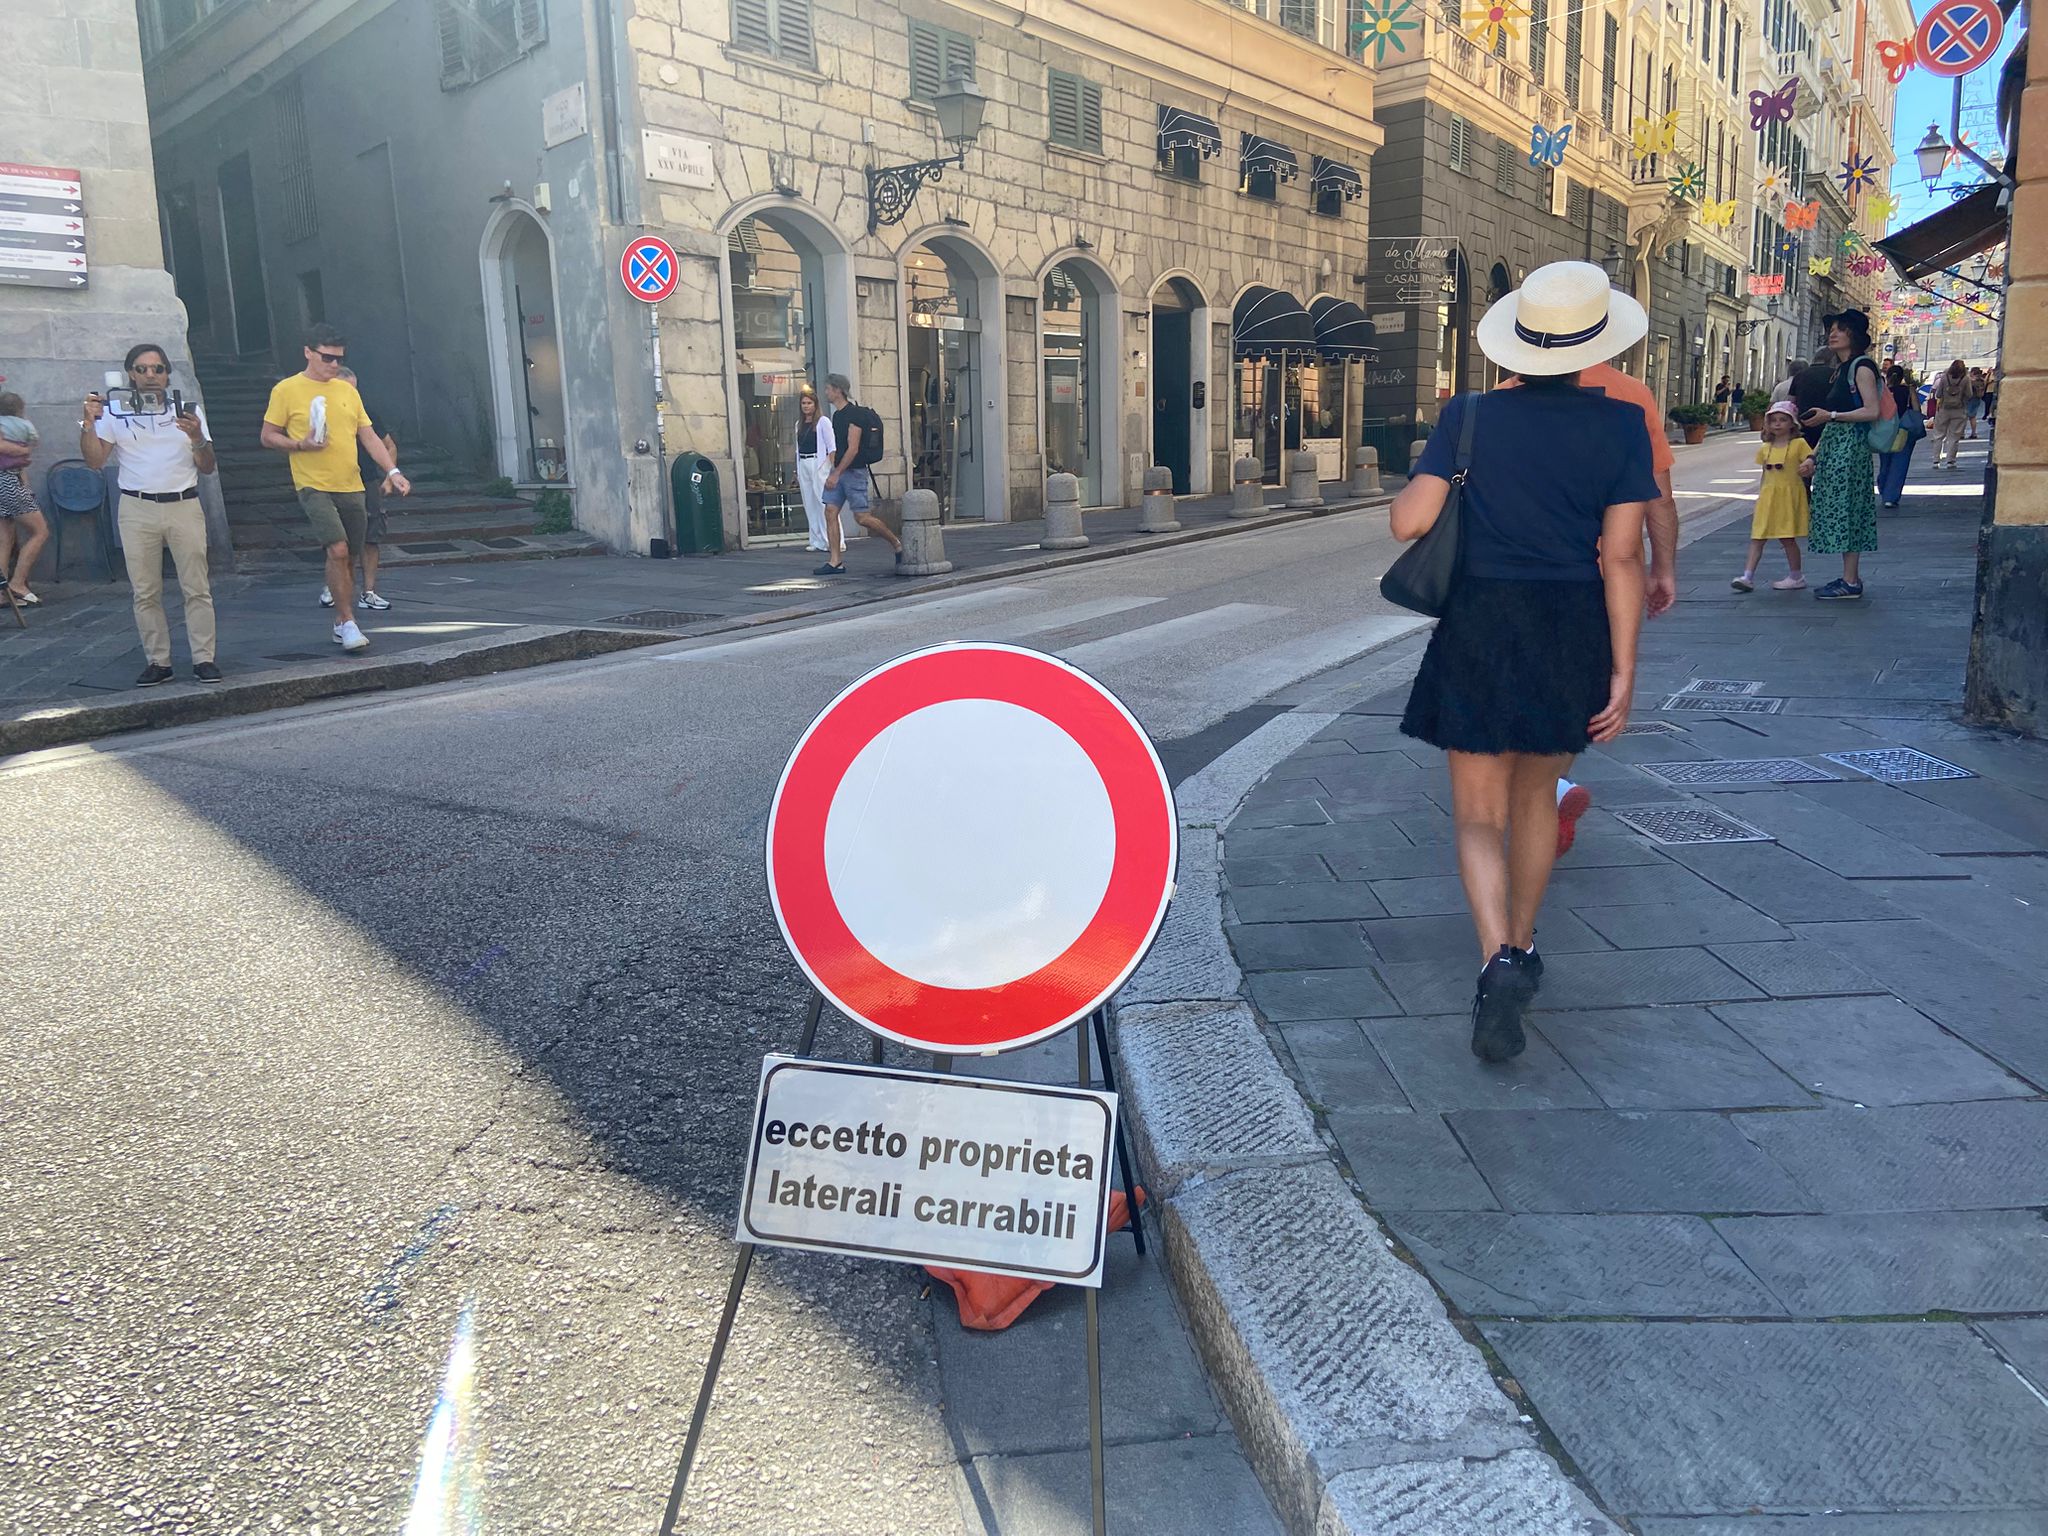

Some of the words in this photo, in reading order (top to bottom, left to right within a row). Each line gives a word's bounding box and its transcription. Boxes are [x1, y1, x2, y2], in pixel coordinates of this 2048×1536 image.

[672, 147, 688, 159] VIA
[657, 159, 673, 170] XXV
[679, 163, 704, 177] APRILE
[1385, 241, 1400, 258] da
[1404, 238, 1449, 261] Maria
[1394, 260, 1436, 270] CUCINA
[765, 1119, 908, 1159] eccetto
[919, 1136, 1094, 1181] proprieta
[768, 1169, 902, 1218] laterali
[914, 1196, 1077, 1240] carrabili
